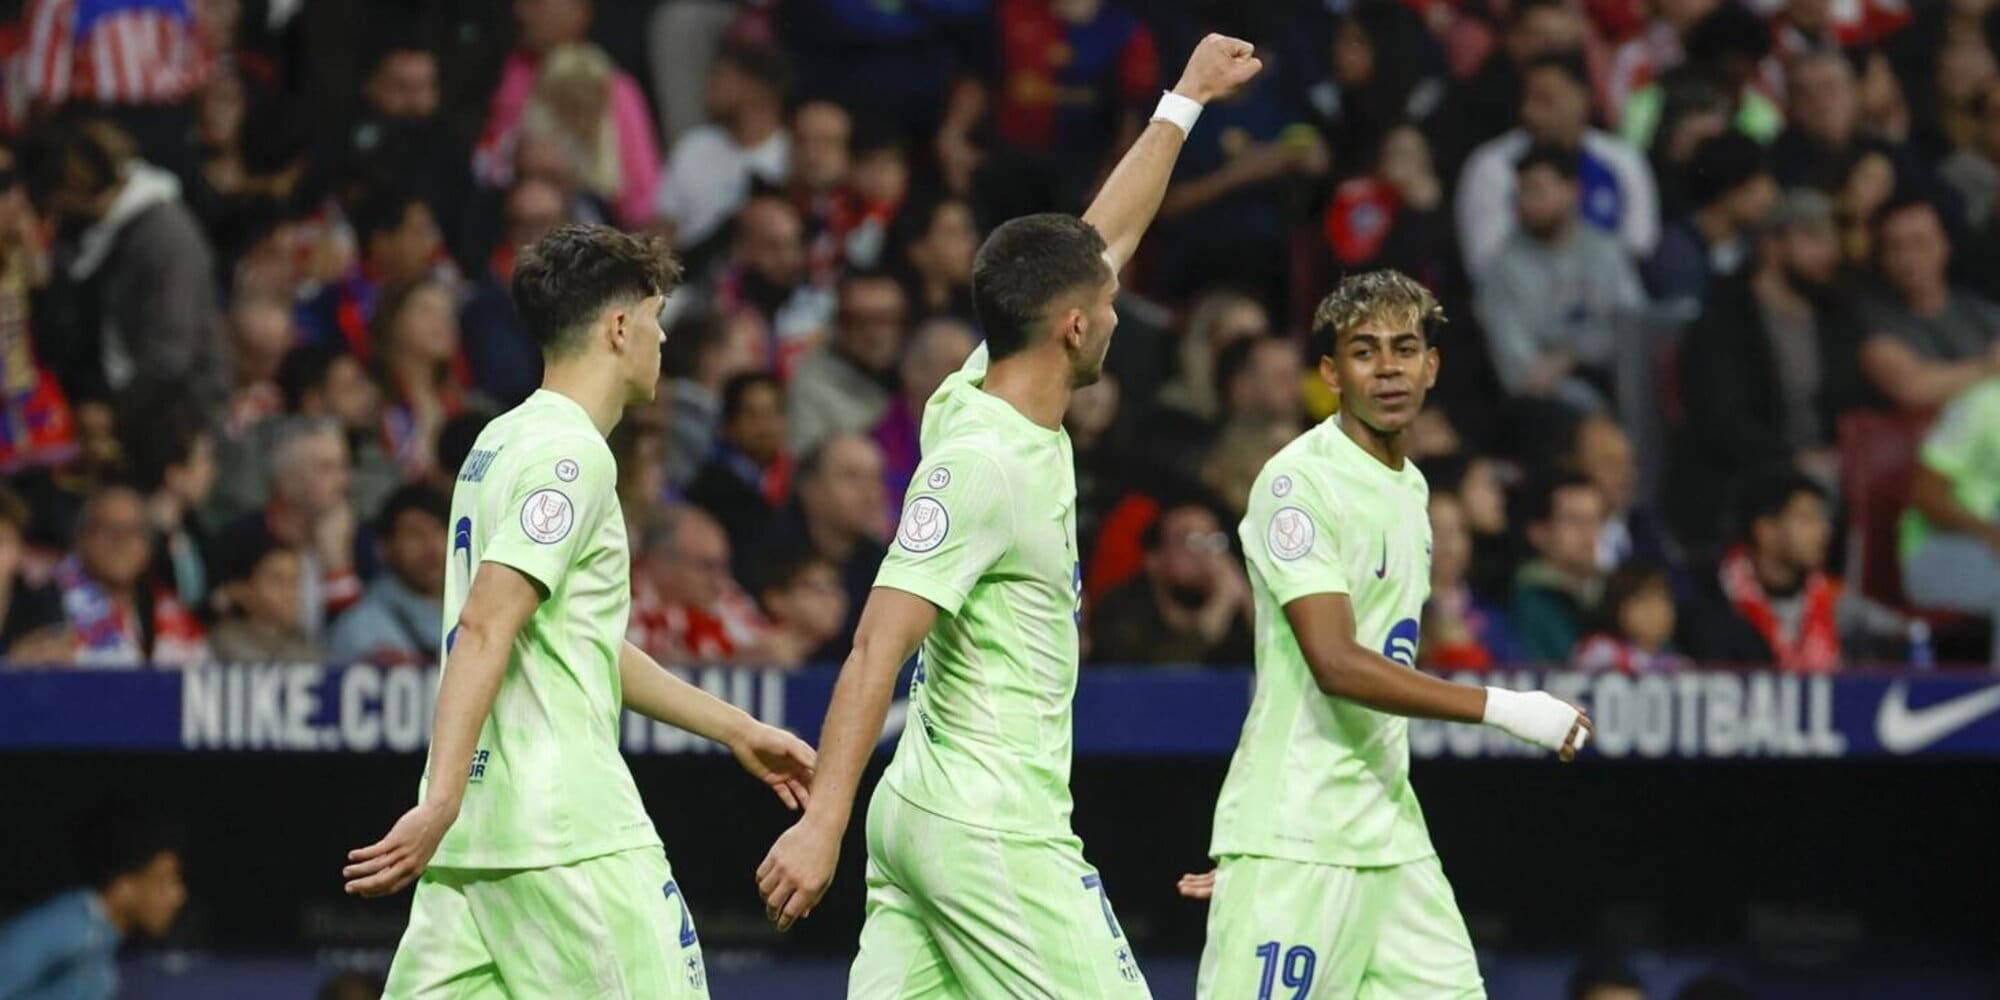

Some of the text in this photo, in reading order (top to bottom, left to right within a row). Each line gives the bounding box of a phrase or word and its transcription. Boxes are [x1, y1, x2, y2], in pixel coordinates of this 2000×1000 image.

[933, 473, 946, 484] 31
[178, 664, 441, 752] NIKE.CO
[1256, 941, 1316, 1000] 19
